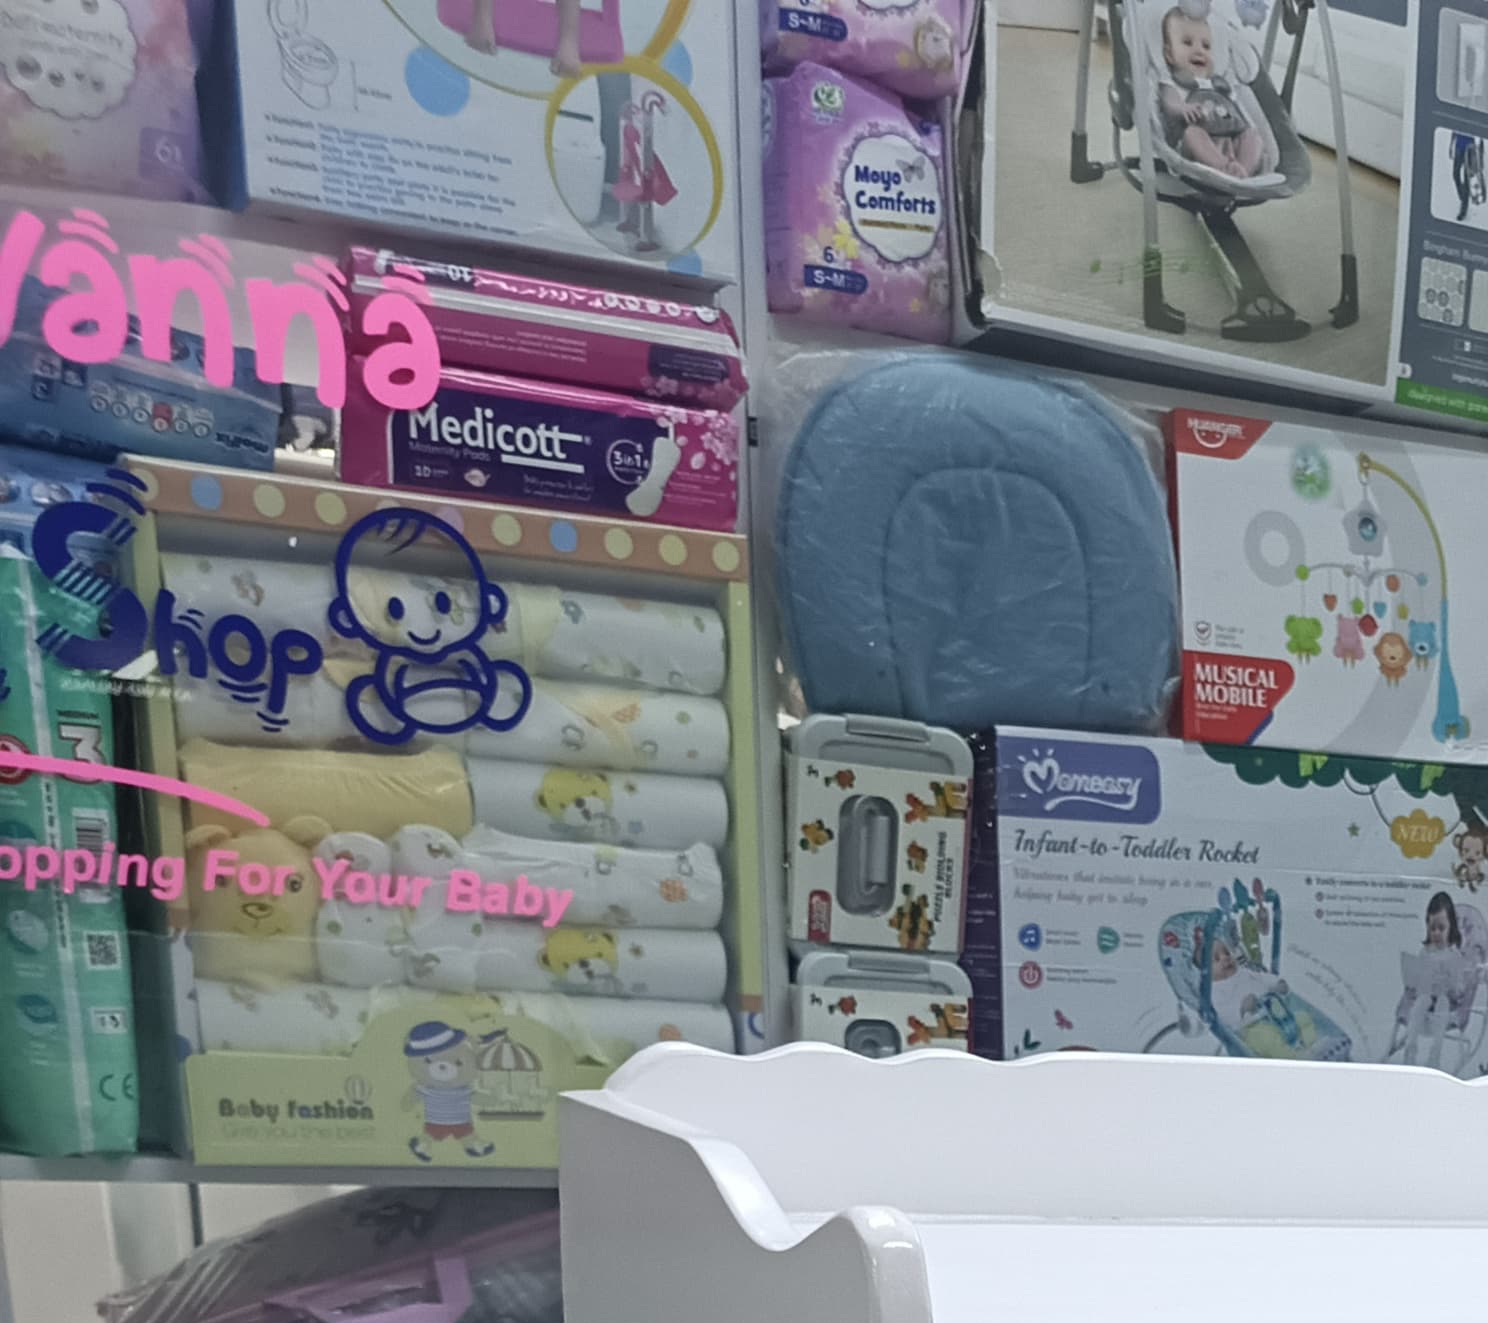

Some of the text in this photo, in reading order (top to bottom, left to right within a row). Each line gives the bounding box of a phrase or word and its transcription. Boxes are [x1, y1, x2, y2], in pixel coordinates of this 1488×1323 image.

[855, 164, 902, 192] Moyo
[855, 191, 936, 215] Comforts
[408, 404, 583, 462] Medicott
[32, 500, 324, 714] Shop
[1194, 663, 1279, 690] MUSICAL
[1194, 683, 1268, 708] MOBILE
[1022, 757, 1142, 811] Momeasy
[1198, 839, 1260, 864] Rocket
[204, 849, 294, 897] For
[316, 859, 430, 908] Your
[446, 869, 574, 928] Baby
[218, 1097, 280, 1123] Baby
